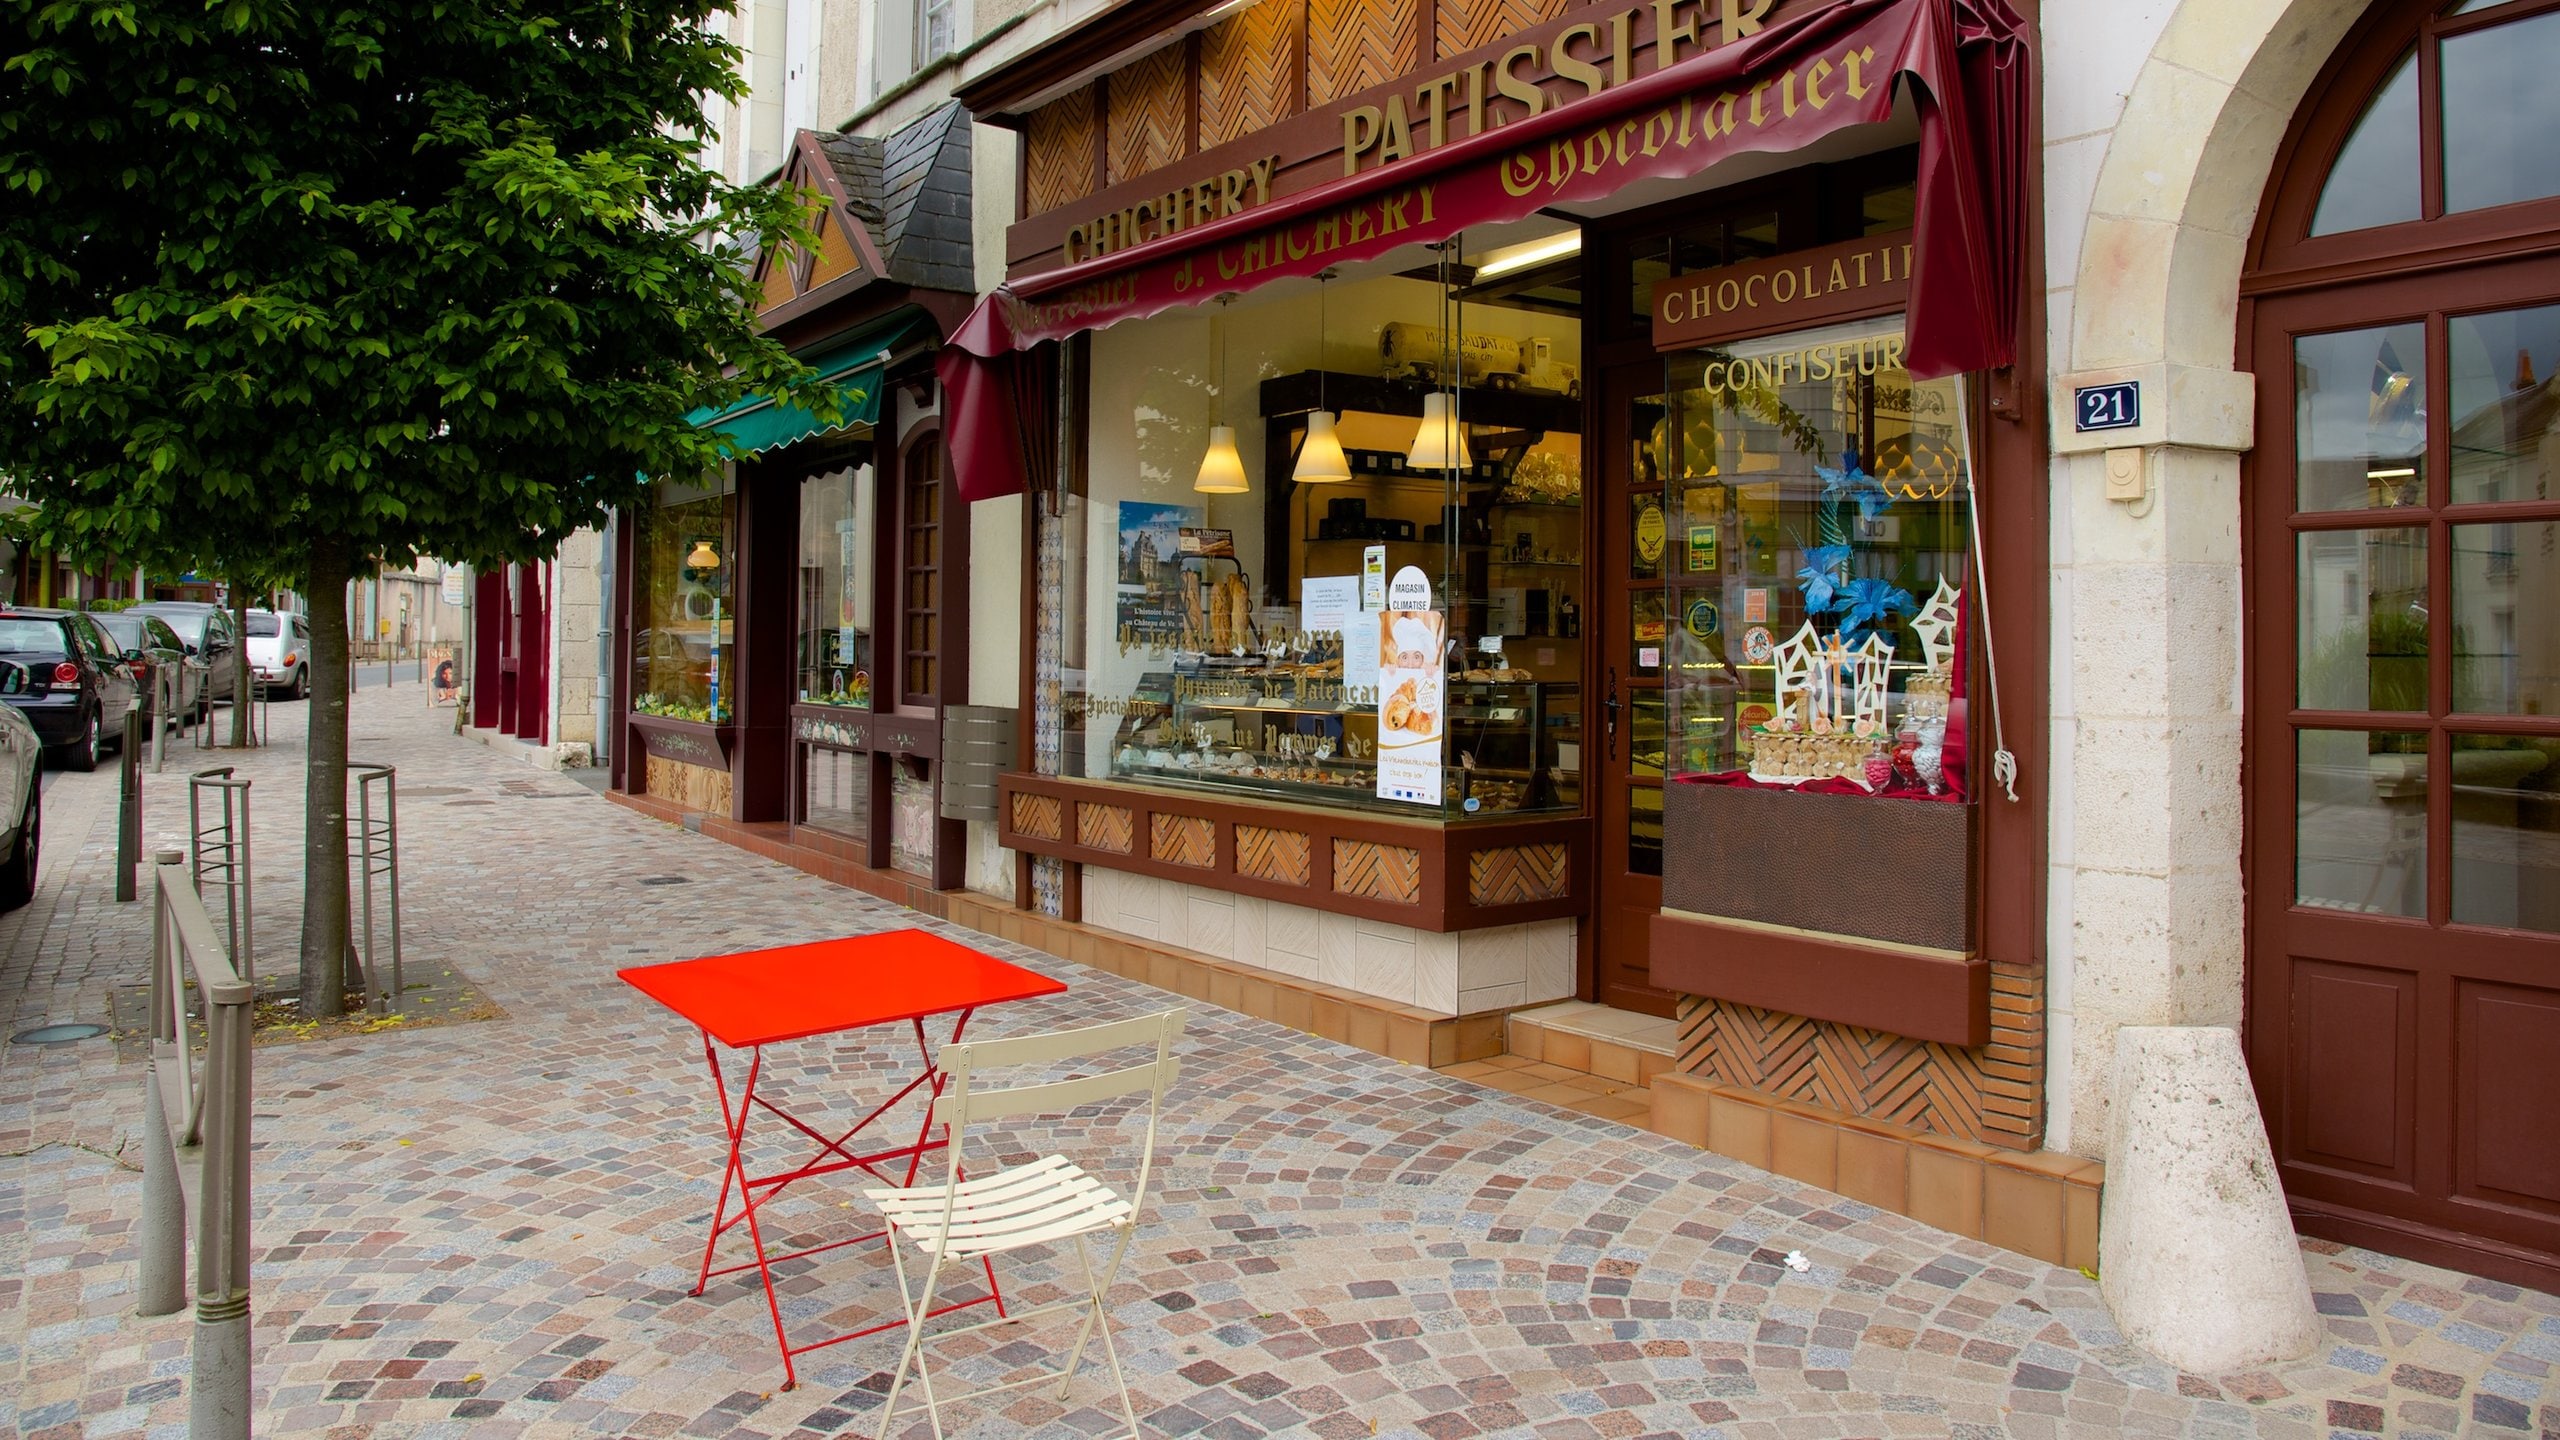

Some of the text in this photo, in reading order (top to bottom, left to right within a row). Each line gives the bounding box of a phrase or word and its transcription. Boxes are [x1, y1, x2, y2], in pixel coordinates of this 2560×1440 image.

[1339, 0, 1778, 178] PATISSIER
[1216, 180, 1440, 281] CHICHERY
[1499, 44, 1877, 197] Chocolatier
[1064, 154, 1281, 267] CHICHERY
[1703, 336, 1907, 395] CONFISEUR
[2087, 390, 2126, 425] 21
[1394, 583, 1426, 593] MAGASIN
[1134, 607, 1162, 616] L'histoire
[1392, 600, 1427, 611] CLIMATISE
[1133, 618, 1158, 628] Château
[1158, 619, 1167, 627] de
[1264, 676, 1283, 699] de
[1743, 710, 1770, 719] Sécurité
[1351, 731, 1372, 756] de
